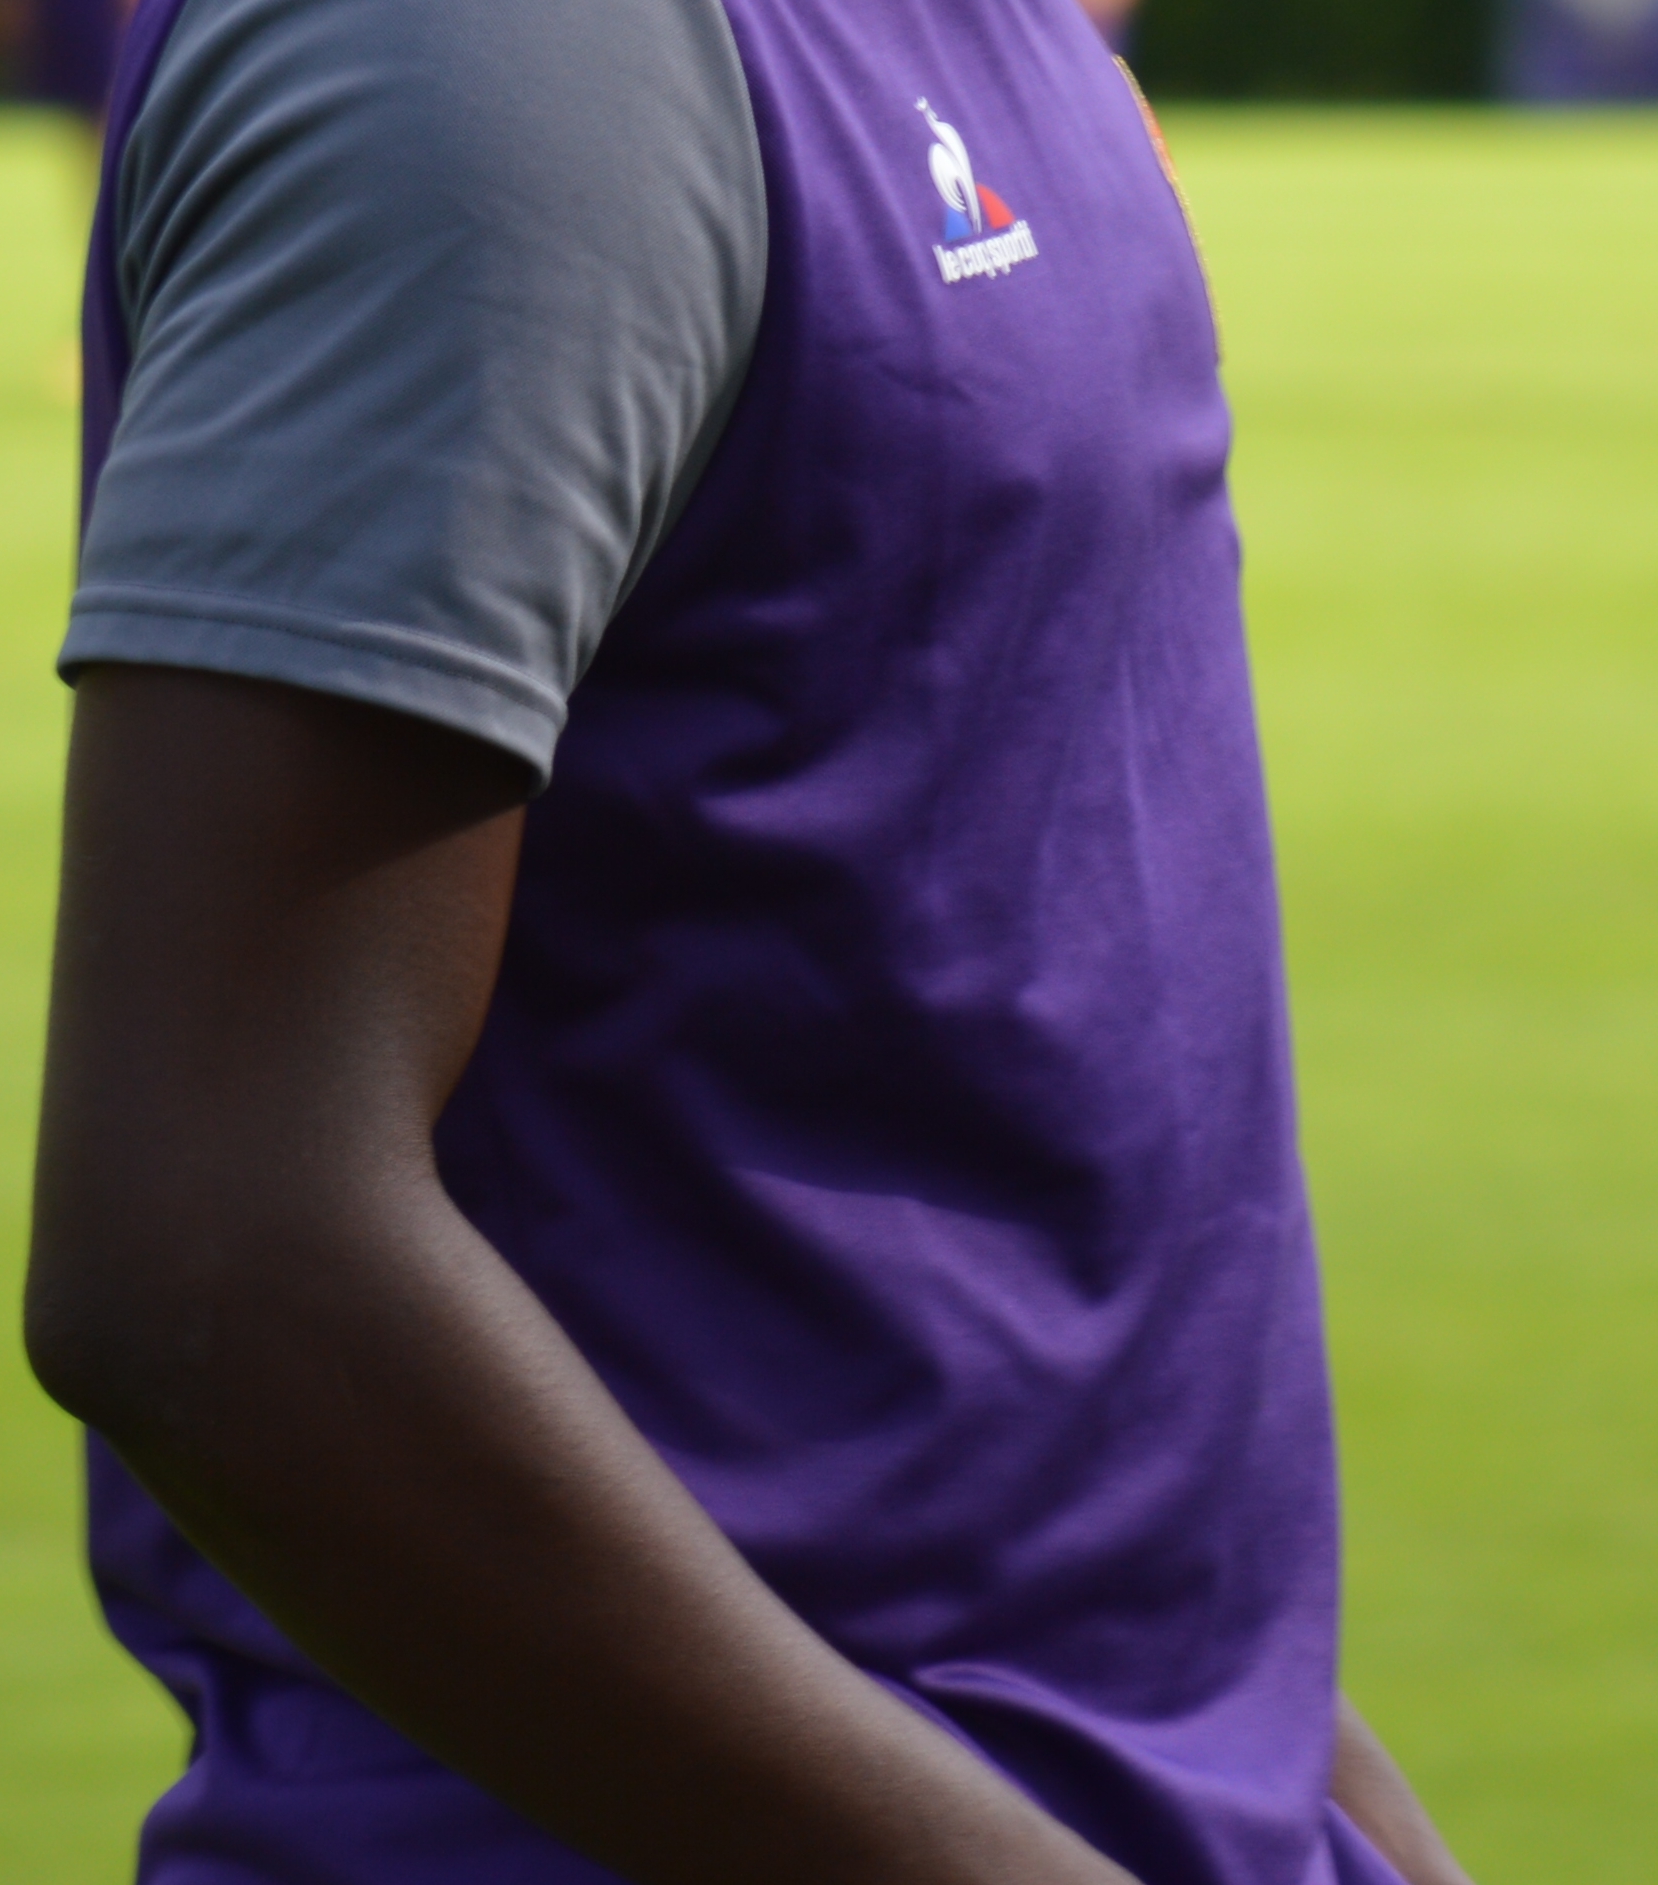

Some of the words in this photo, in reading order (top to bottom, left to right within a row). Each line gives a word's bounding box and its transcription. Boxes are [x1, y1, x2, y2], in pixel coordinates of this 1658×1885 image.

[933, 244, 961, 284] le
[955, 242, 996, 279] coq
[985, 219, 1038, 275] sportif
